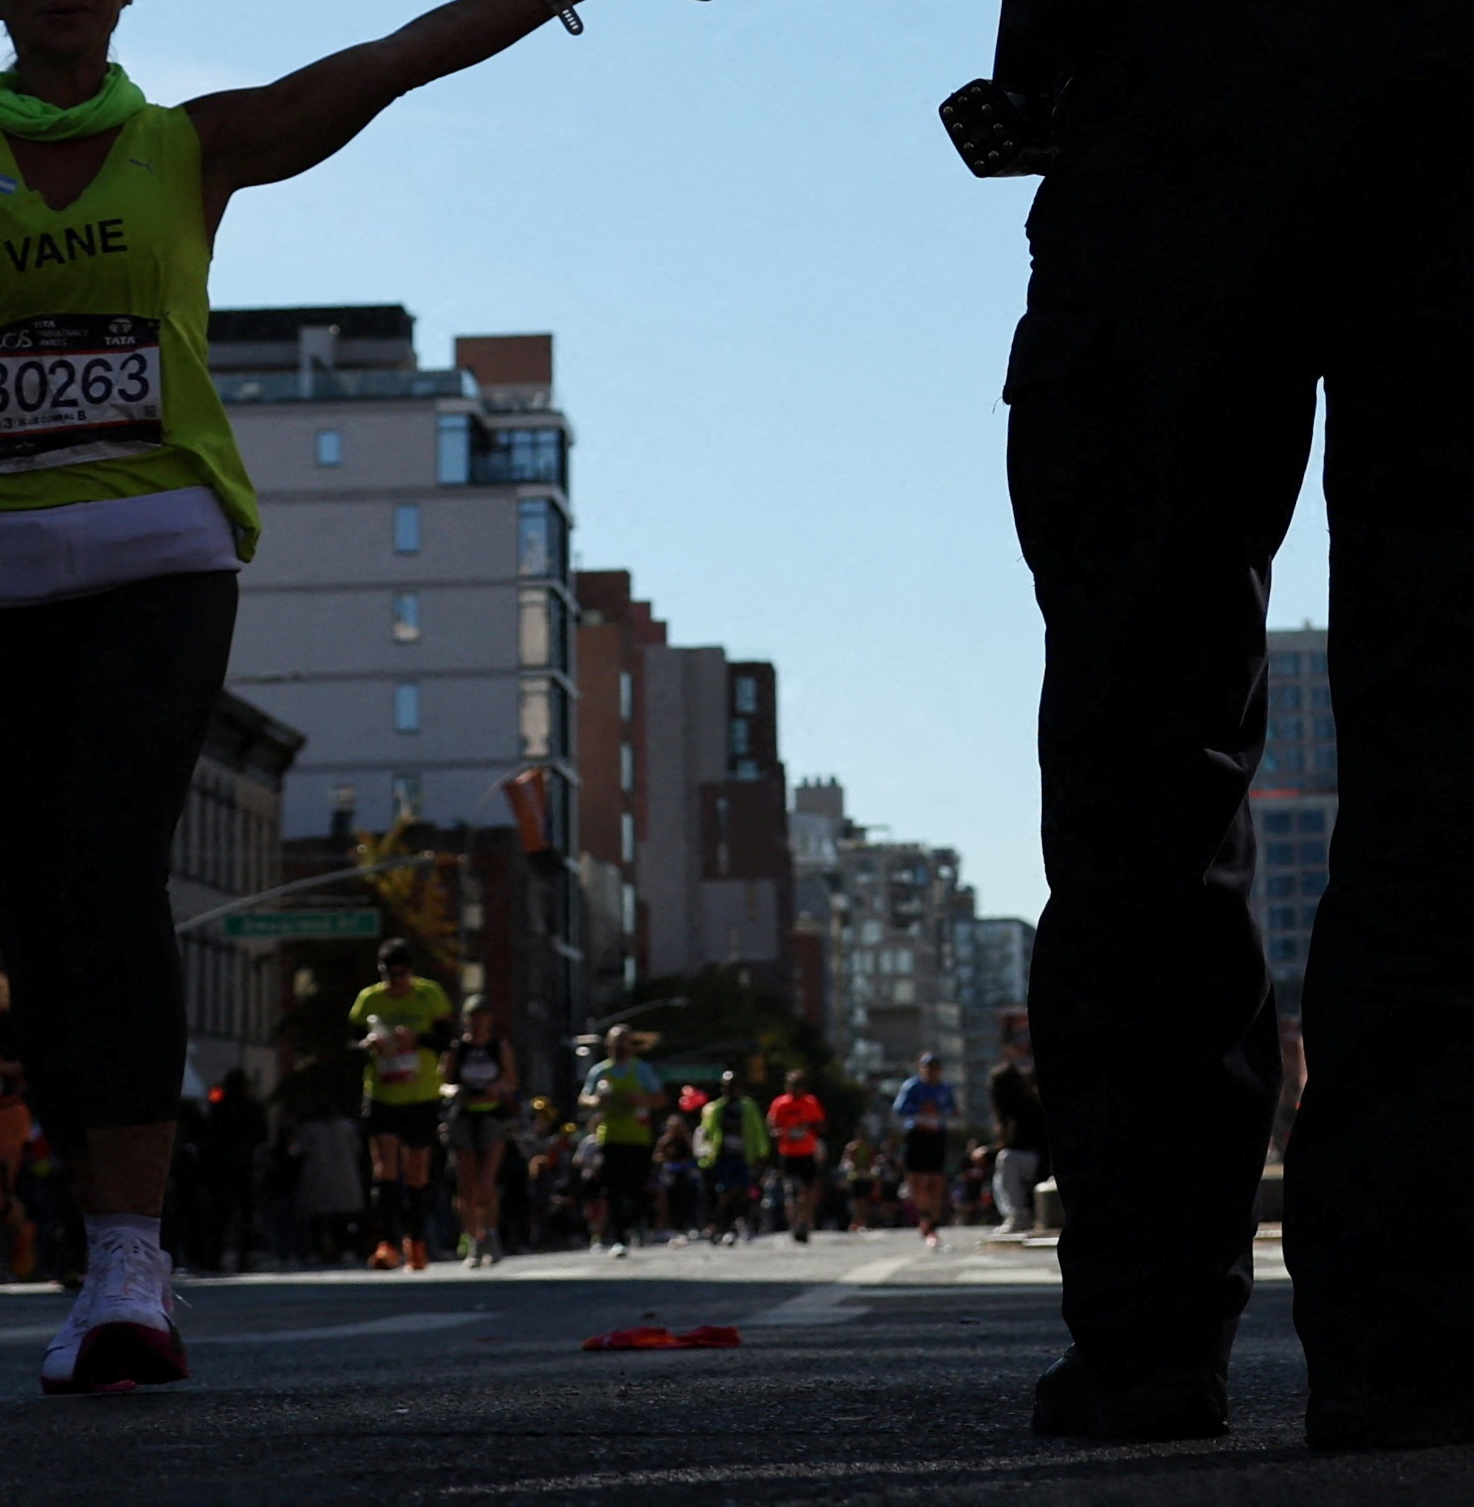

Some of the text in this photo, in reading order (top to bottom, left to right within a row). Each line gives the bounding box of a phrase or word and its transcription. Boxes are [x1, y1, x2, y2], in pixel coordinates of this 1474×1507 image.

[4, 219, 127, 272] VANE
[104, 335, 137, 346] TATA
[4, 417, 13, 429] 3
[77, 409, 87, 421] B
